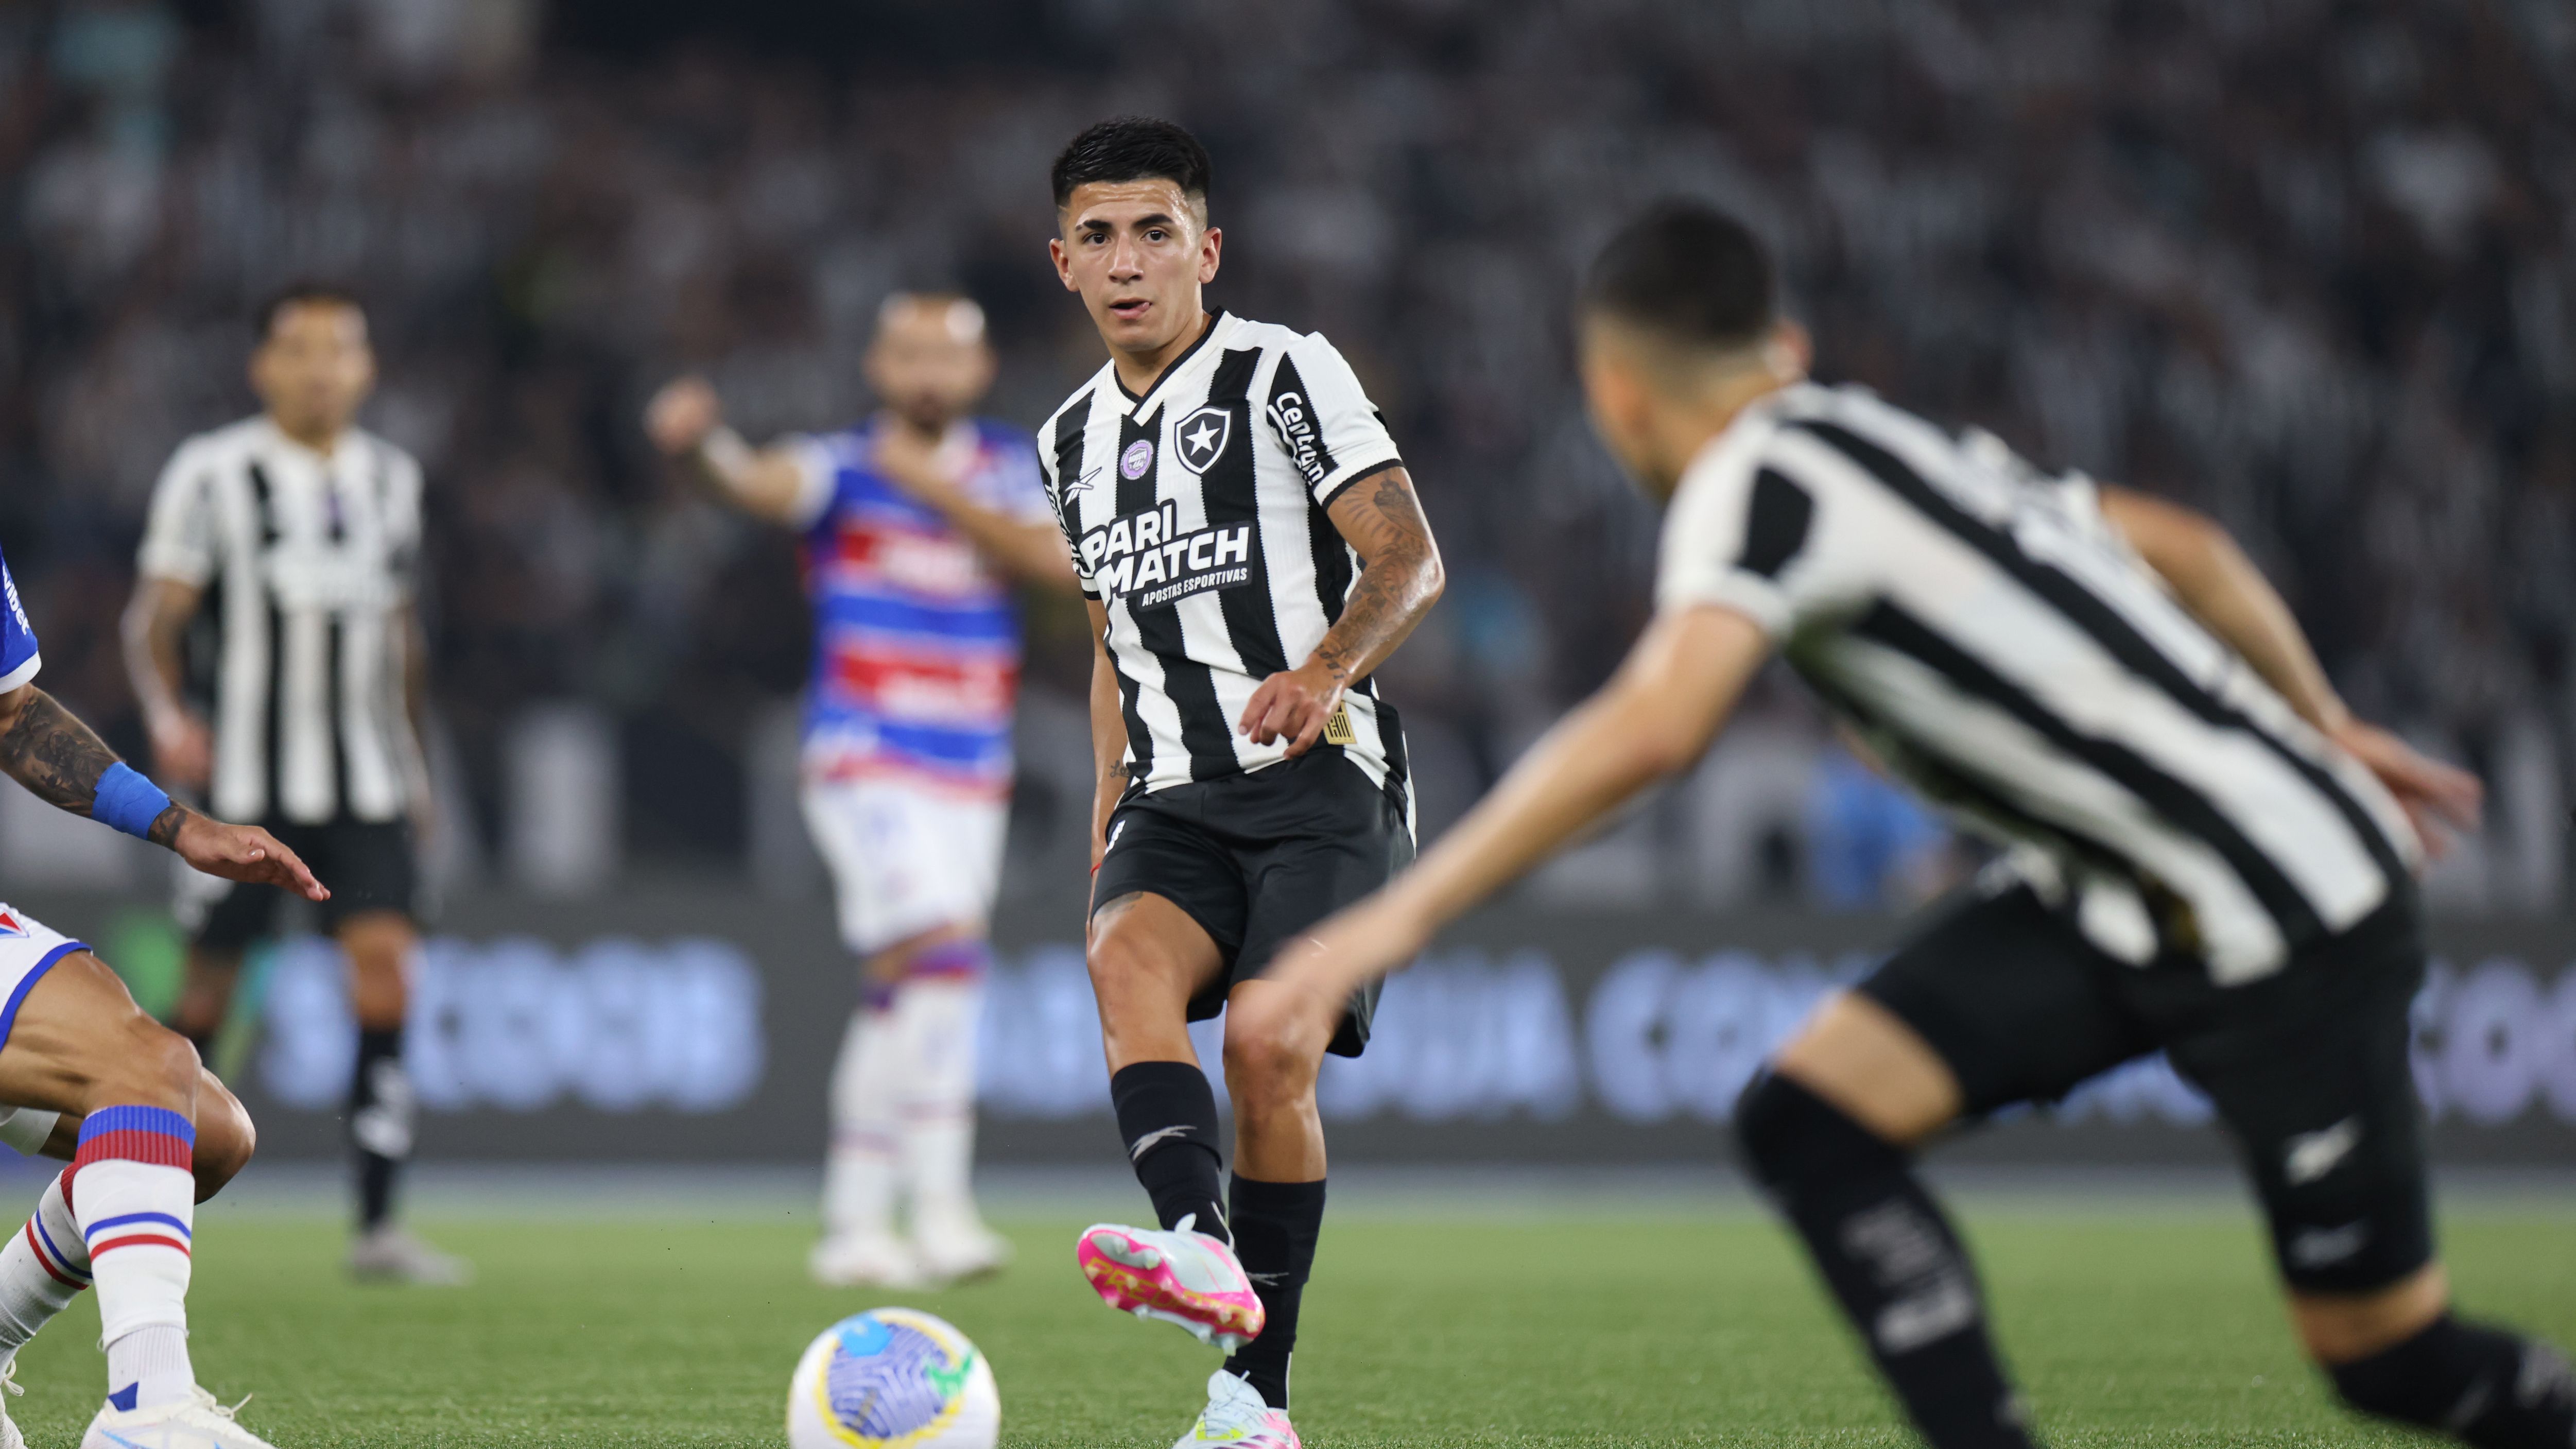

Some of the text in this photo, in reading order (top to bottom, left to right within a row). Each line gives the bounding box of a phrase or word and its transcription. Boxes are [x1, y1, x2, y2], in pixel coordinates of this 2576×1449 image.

[1276, 392, 1325, 483] Centrum
[1079, 504, 1172, 575] PARI
[1094, 526, 1250, 609] MATCH
[1142, 567, 1248, 607] APOSTAS ESPORTIVAS
